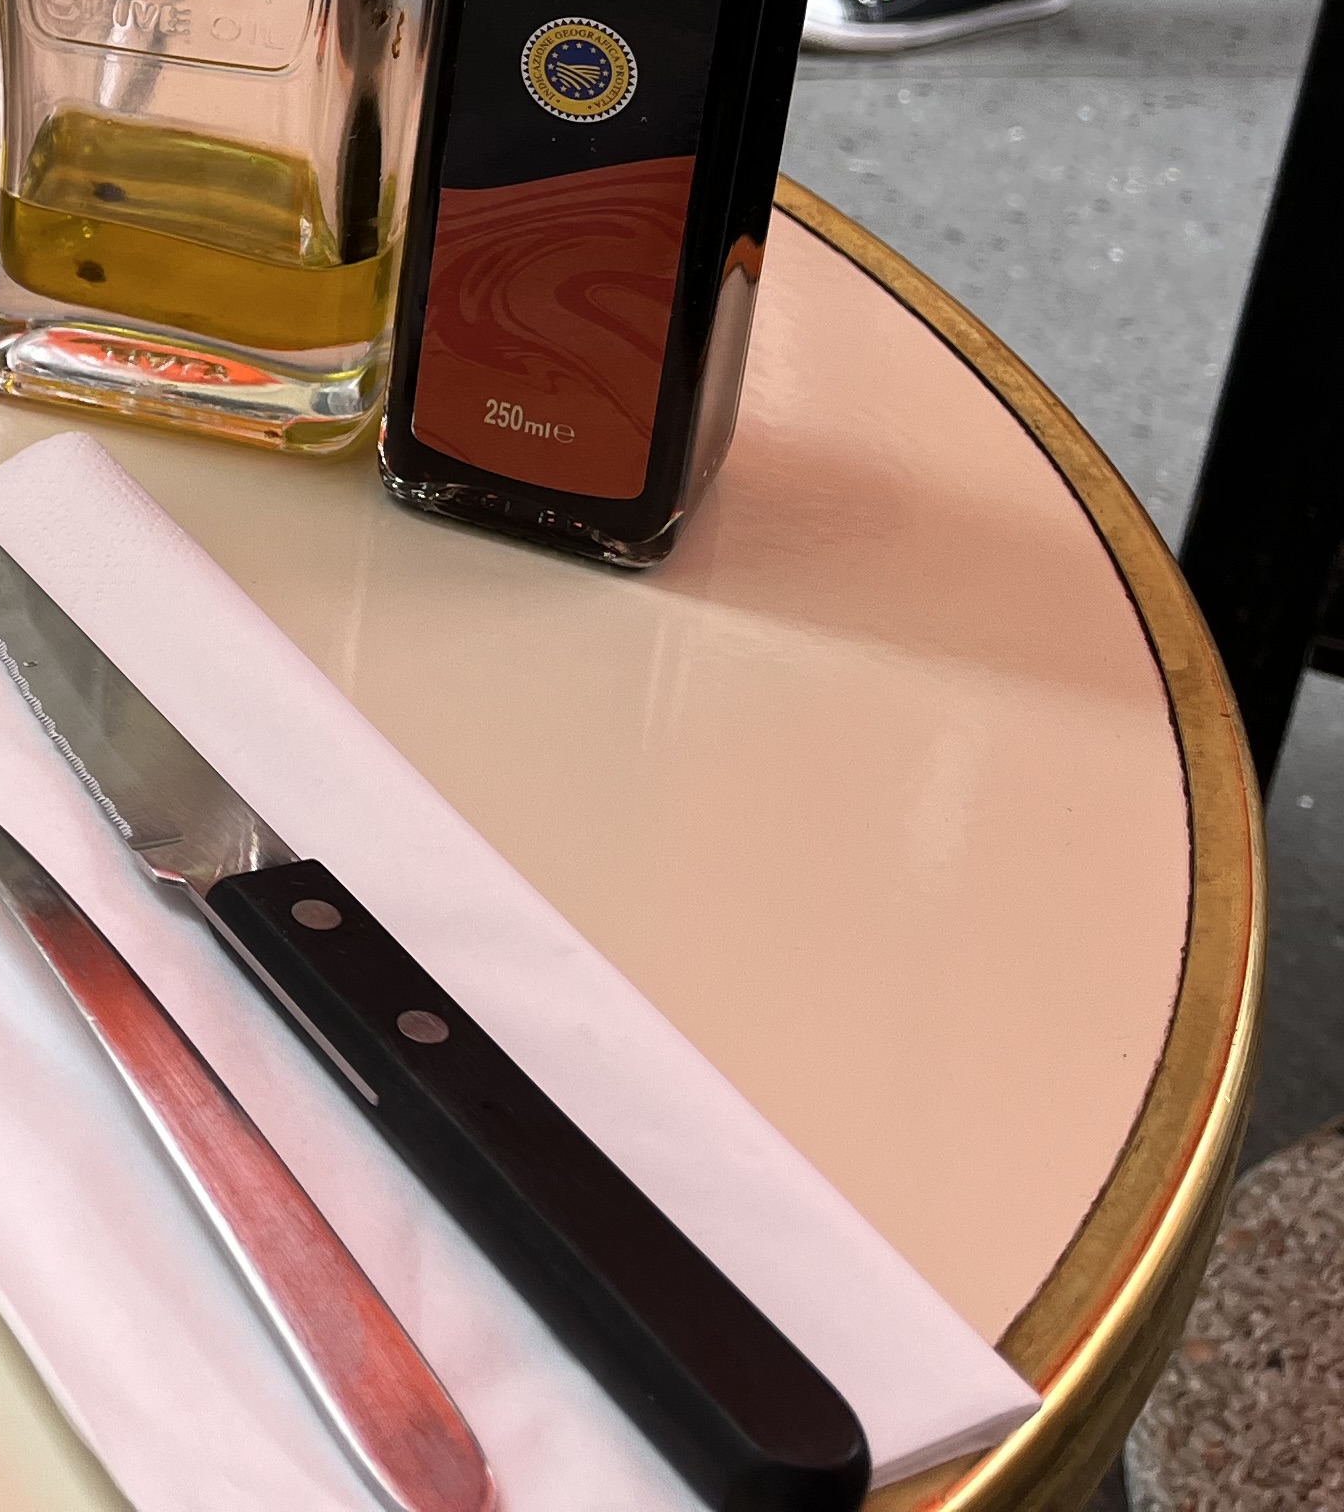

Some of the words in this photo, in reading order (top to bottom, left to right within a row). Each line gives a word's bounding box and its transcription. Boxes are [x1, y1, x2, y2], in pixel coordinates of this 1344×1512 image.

[211, 16, 285, 51] OIL
[532, 36, 554, 101] INDICAZIONE
[554, 28, 620, 63] GEOGRAFICA
[593, 65, 625, 109] PROTETTA
